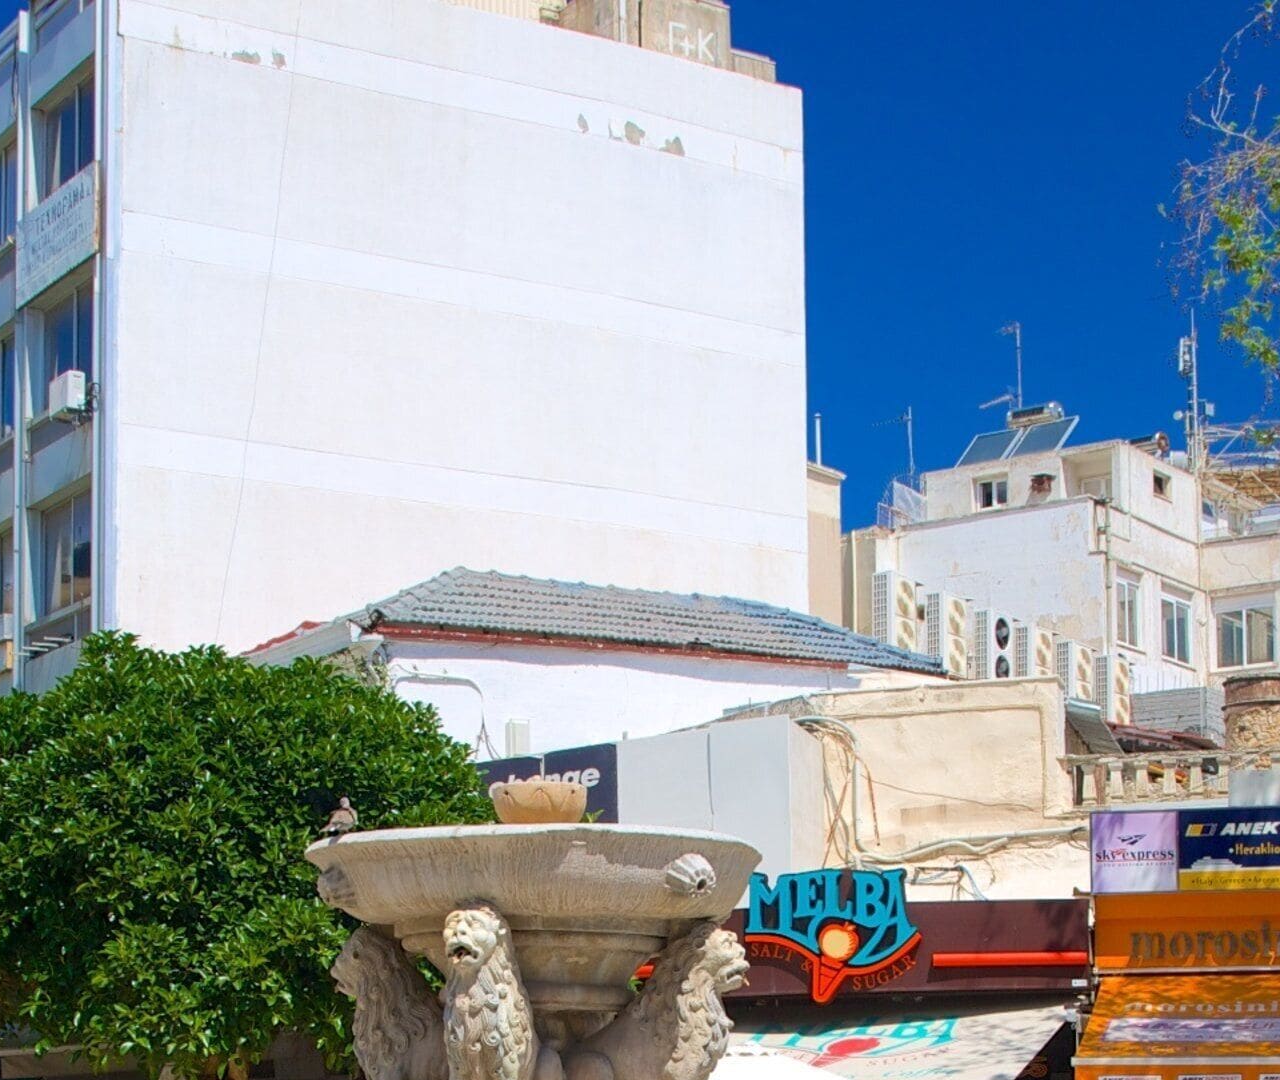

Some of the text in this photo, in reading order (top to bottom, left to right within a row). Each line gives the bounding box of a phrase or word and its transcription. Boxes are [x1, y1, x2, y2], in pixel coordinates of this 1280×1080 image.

[1221, 821, 1280, 836] ANEK
[1123, 849, 1175, 862] express
[745, 869, 918, 966] MELBA
[751, 943, 797, 962] SALT
[852, 954, 917, 991] SUGAR
[1124, 1000, 1279, 1014] morosini
